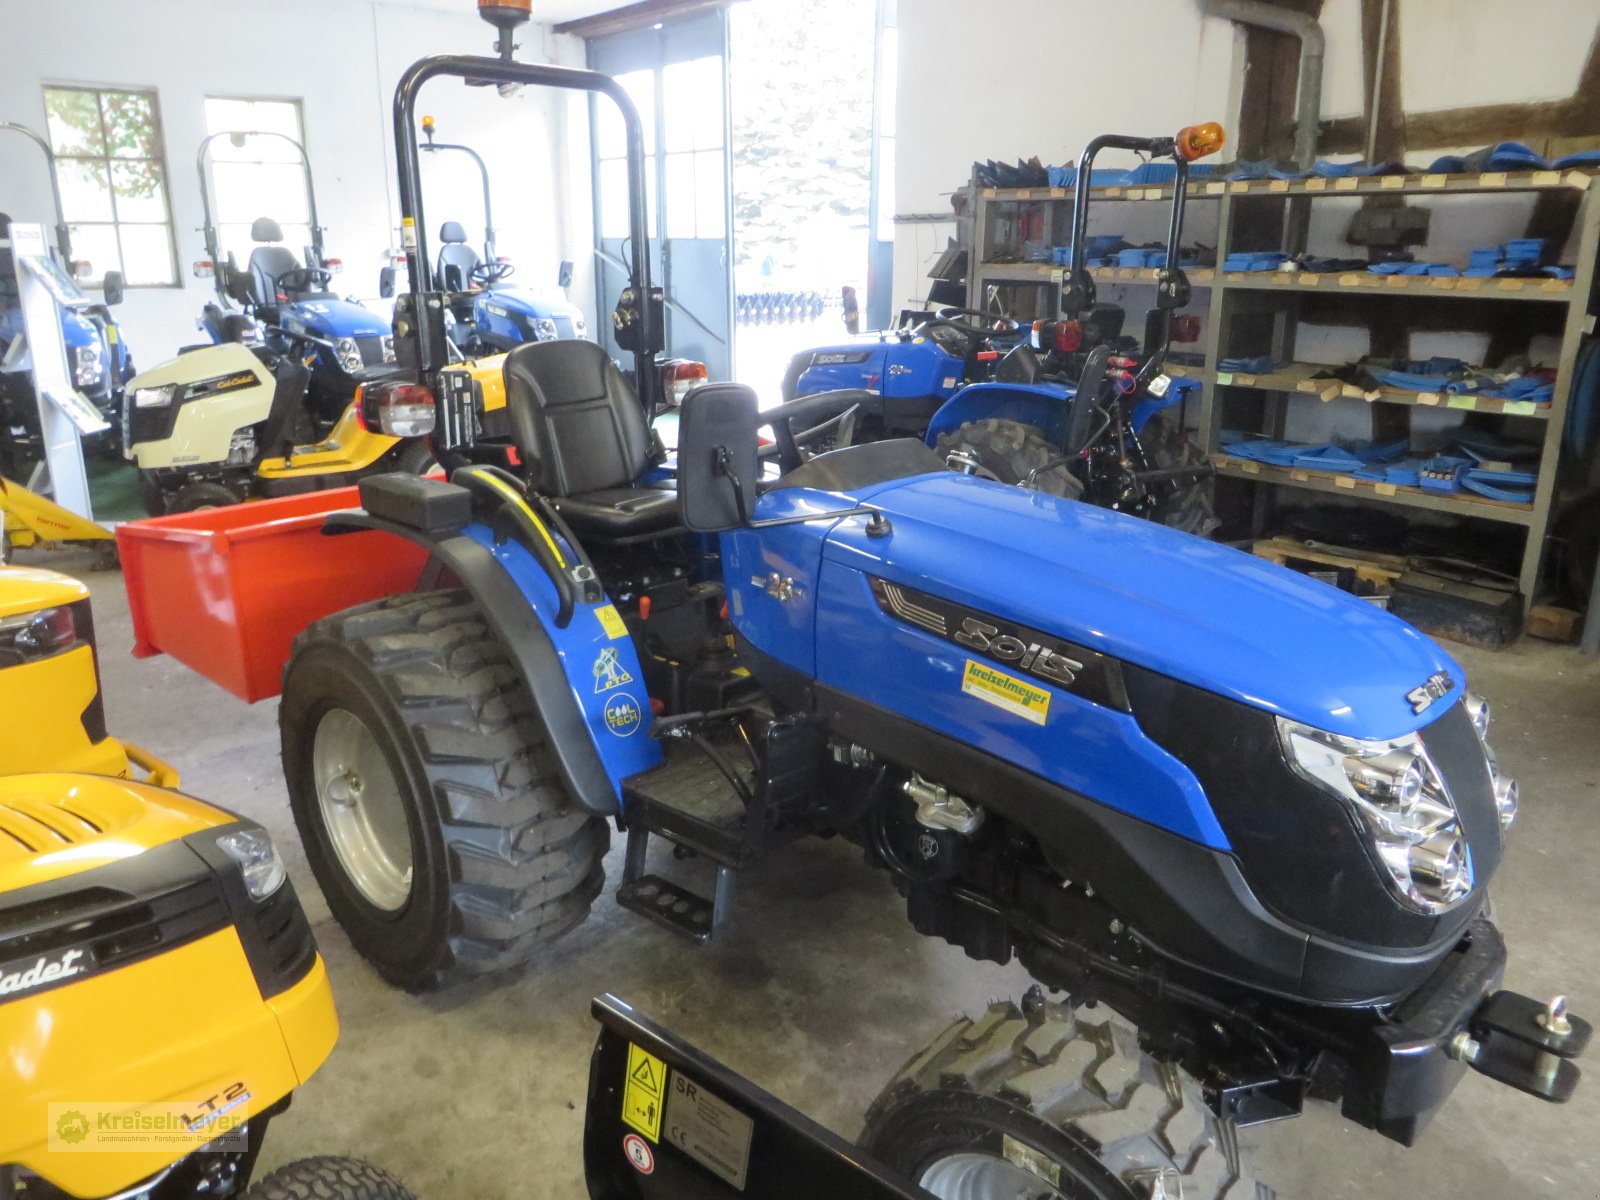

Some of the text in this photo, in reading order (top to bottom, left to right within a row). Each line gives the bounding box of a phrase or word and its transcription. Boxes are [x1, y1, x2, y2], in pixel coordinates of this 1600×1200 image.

[605, 672, 630, 689] PTO
[968, 662, 1048, 706] kreiselmeyer
[610, 713, 638, 728] TECH
[0, 949, 83, 995] adet
[675, 1077, 697, 1102] SR
[634, 1147, 643, 1161] 5
